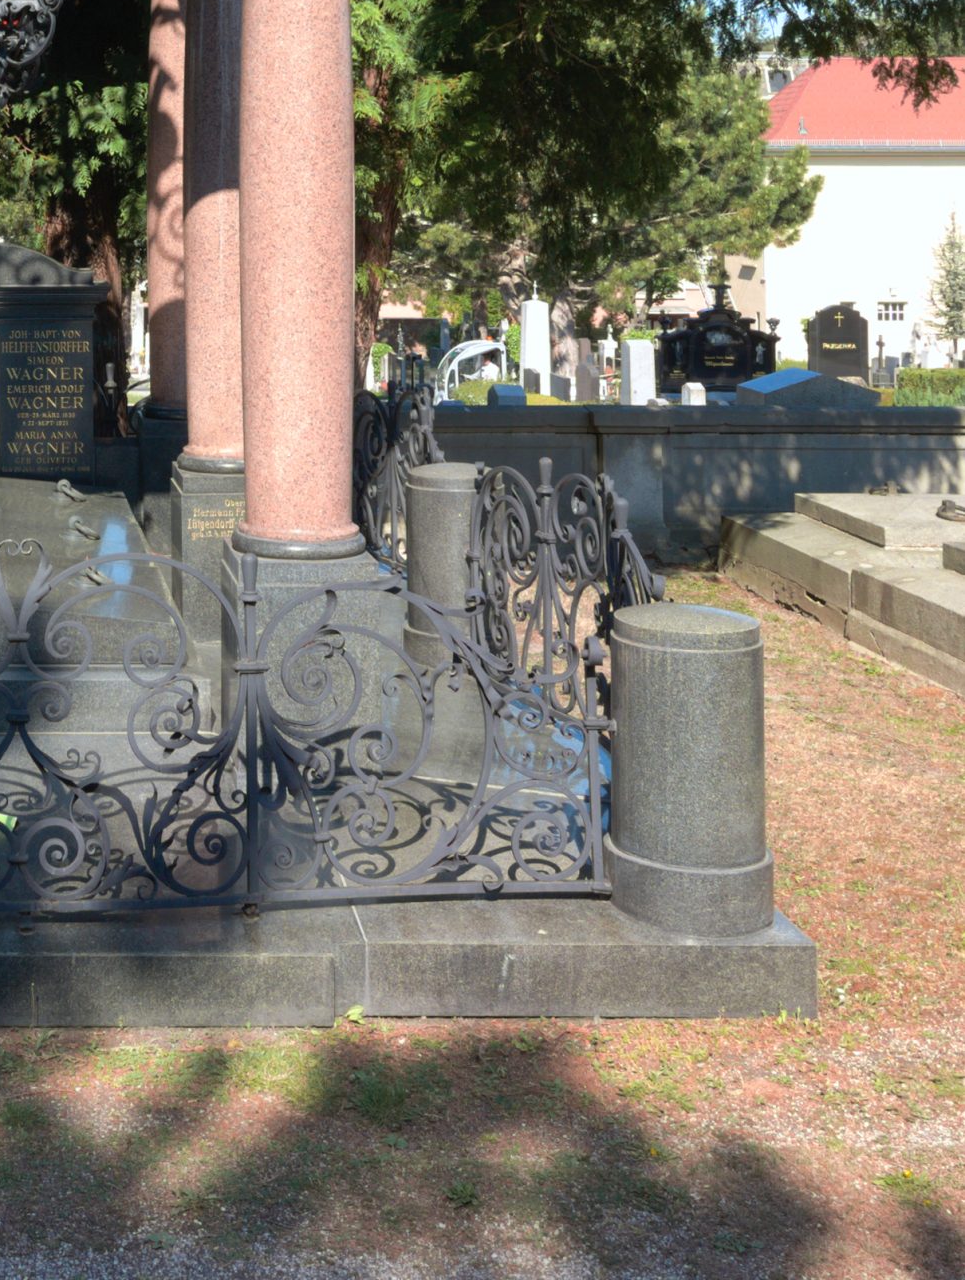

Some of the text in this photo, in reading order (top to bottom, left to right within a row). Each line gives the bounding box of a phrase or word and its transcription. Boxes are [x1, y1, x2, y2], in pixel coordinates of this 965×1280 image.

[27, 355, 64, 365] SIMEON
[6, 367, 84, 381] WAGNER
[7, 384, 85, 393] EMERICH ADOLF
[7, 396, 84, 409] WAGNER
[15, 431, 78, 440] MARIA ANNA
[7, 441, 85, 455] WAGNER
